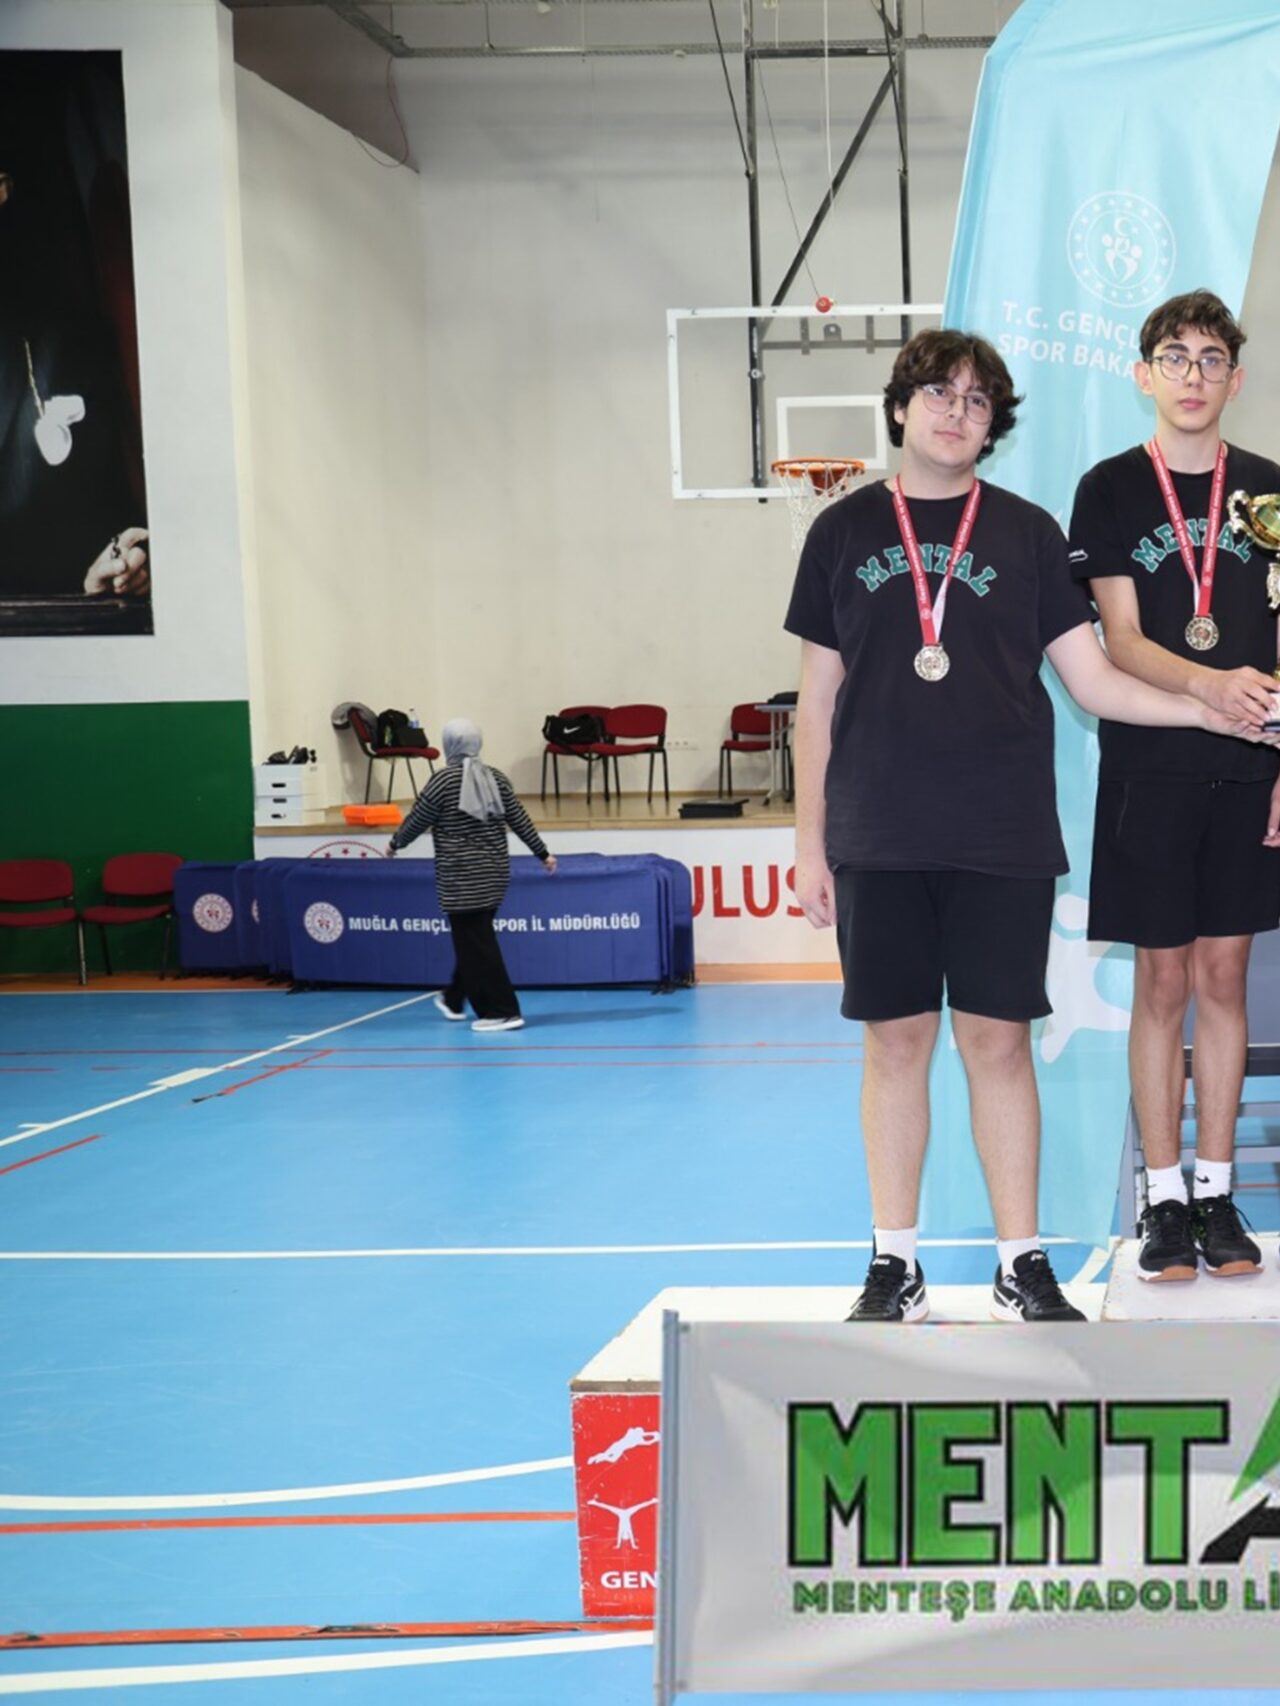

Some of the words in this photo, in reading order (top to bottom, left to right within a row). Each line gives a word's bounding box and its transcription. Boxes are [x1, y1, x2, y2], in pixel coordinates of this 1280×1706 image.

[1002, 301, 1048, 329] T.C.
[1058, 310, 1140, 350] GENÇL
[998, 334, 1065, 364] SPOR
[1073, 344, 1138, 379] BAKA
[855, 543, 997, 597] MENTAL
[348, 915, 399, 931] MUĞLA
[402, 917, 452, 935] GENÇL
[532, 914, 545, 931] İL
[549, 912, 641, 931] MÜDÜRLÜĞÜ
[600, 1570, 658, 1589] GEN
[793, 1579, 997, 1622] MENTEŞE
[1008, 1579, 1228, 1613] ANADOLU
